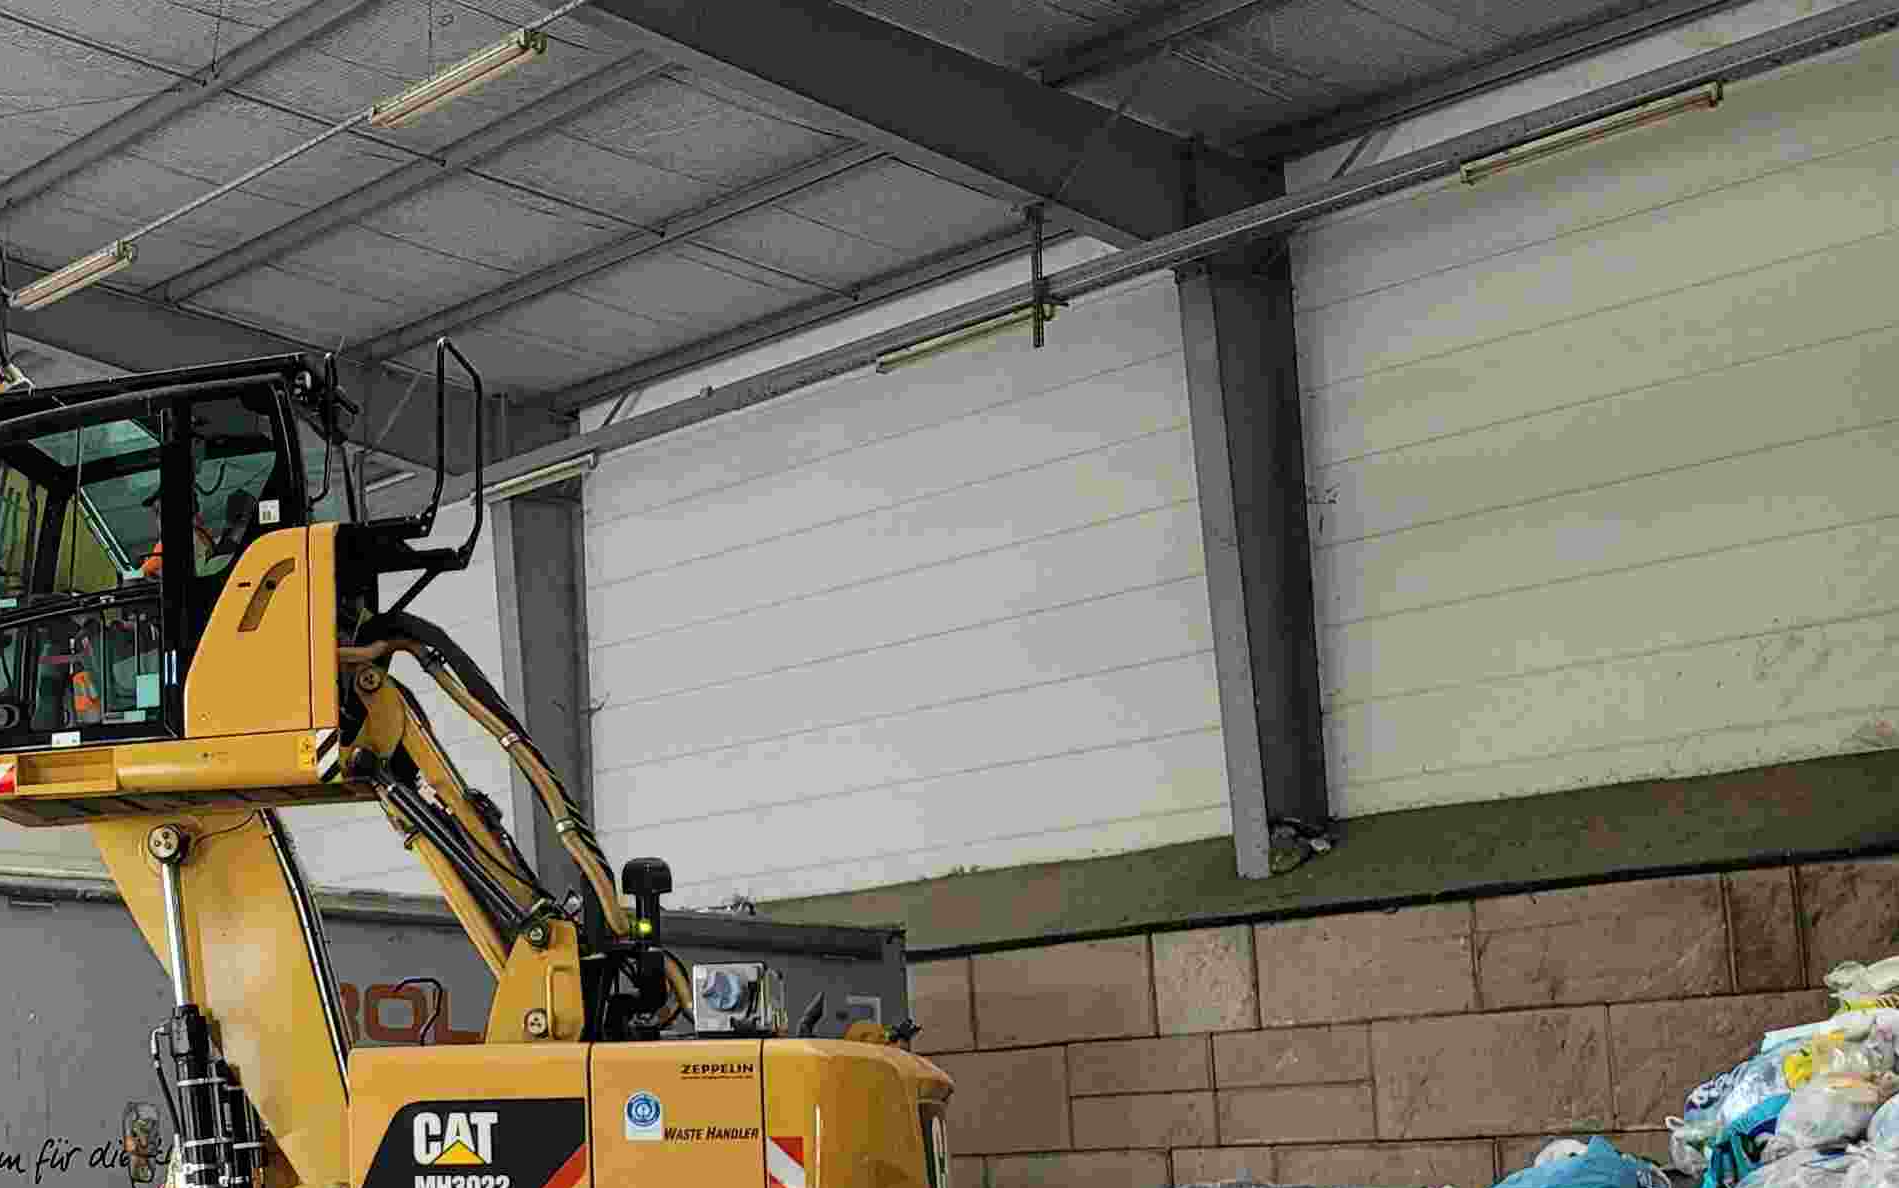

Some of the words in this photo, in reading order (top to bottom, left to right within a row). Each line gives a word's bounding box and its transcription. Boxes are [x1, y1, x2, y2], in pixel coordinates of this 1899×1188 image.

[680, 1063, 754, 1074] ZEPPELIN
[35, 1138, 82, 1184] für
[412, 1111, 499, 1167] CAT
